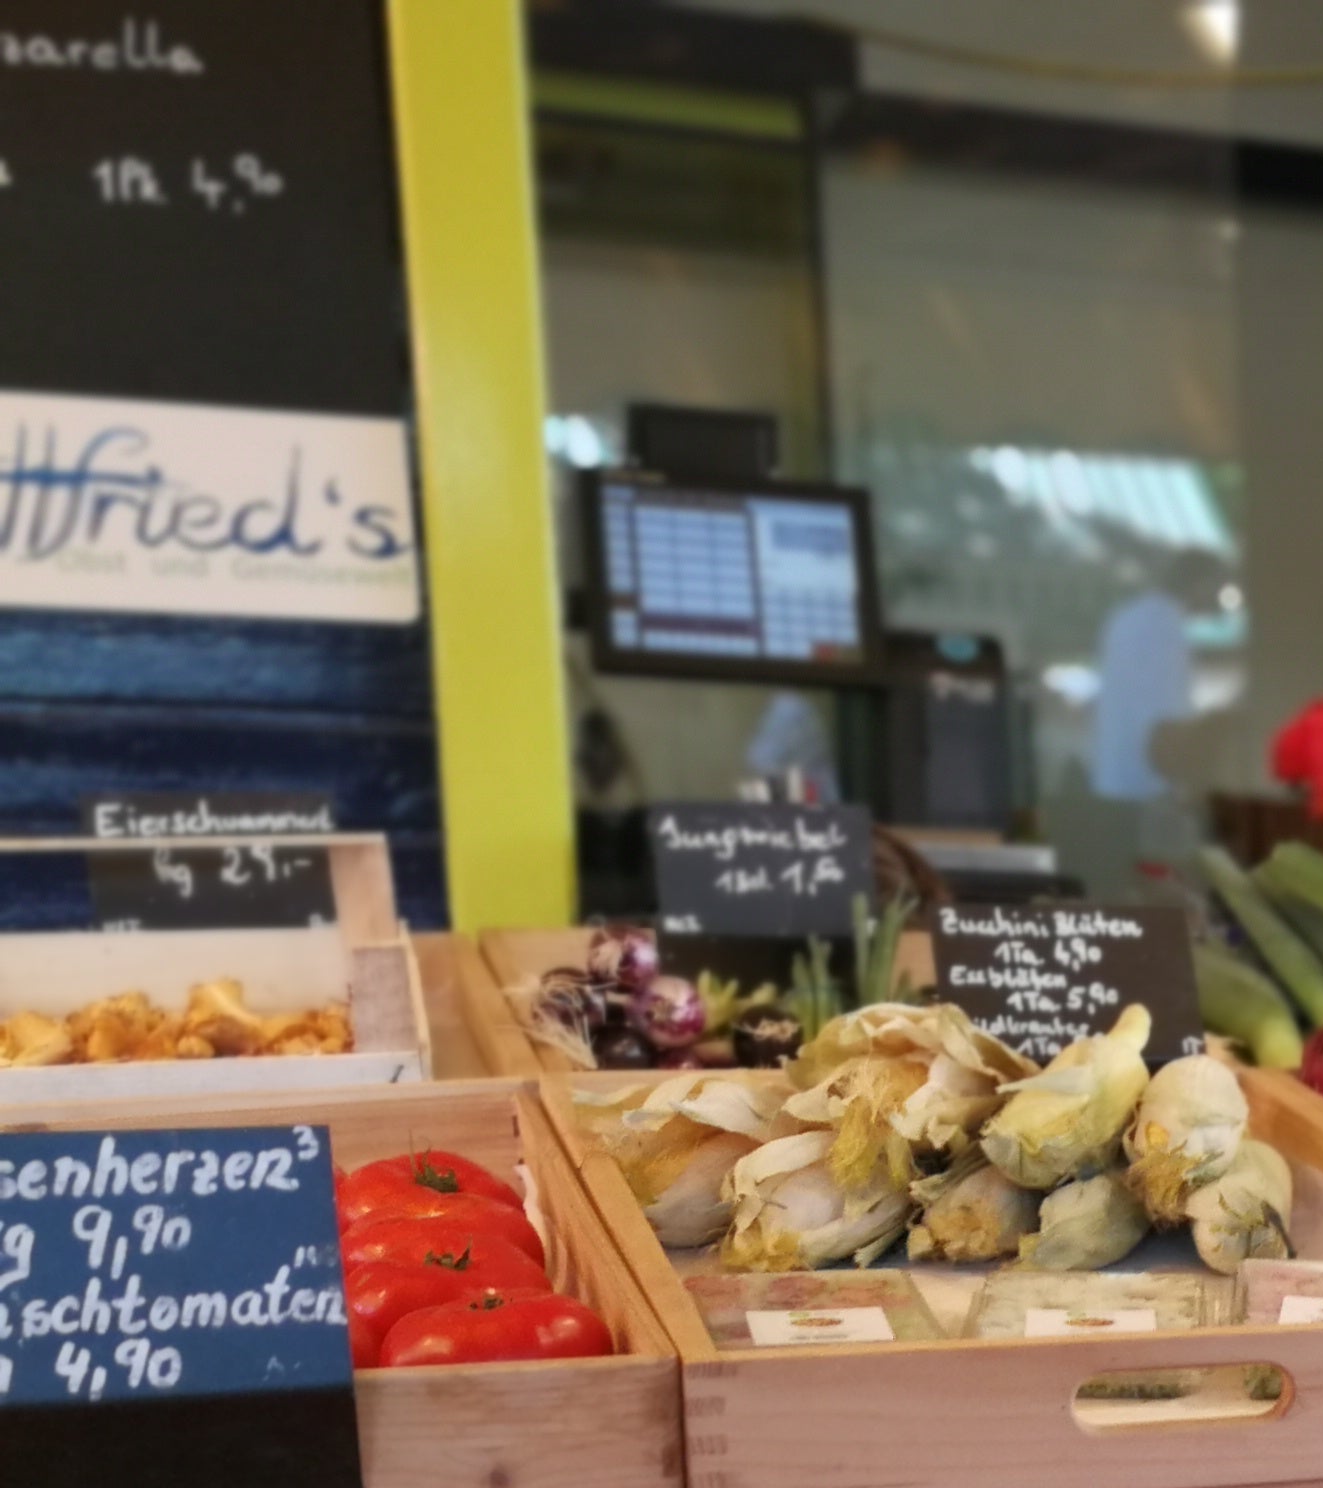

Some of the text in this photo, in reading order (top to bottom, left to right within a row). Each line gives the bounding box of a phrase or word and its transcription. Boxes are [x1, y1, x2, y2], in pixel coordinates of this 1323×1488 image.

[937, 904, 1050, 938] Zucchini
[72, 1203, 192, 1281] 9,90
[54, 1337, 182, 1402] 4,90
